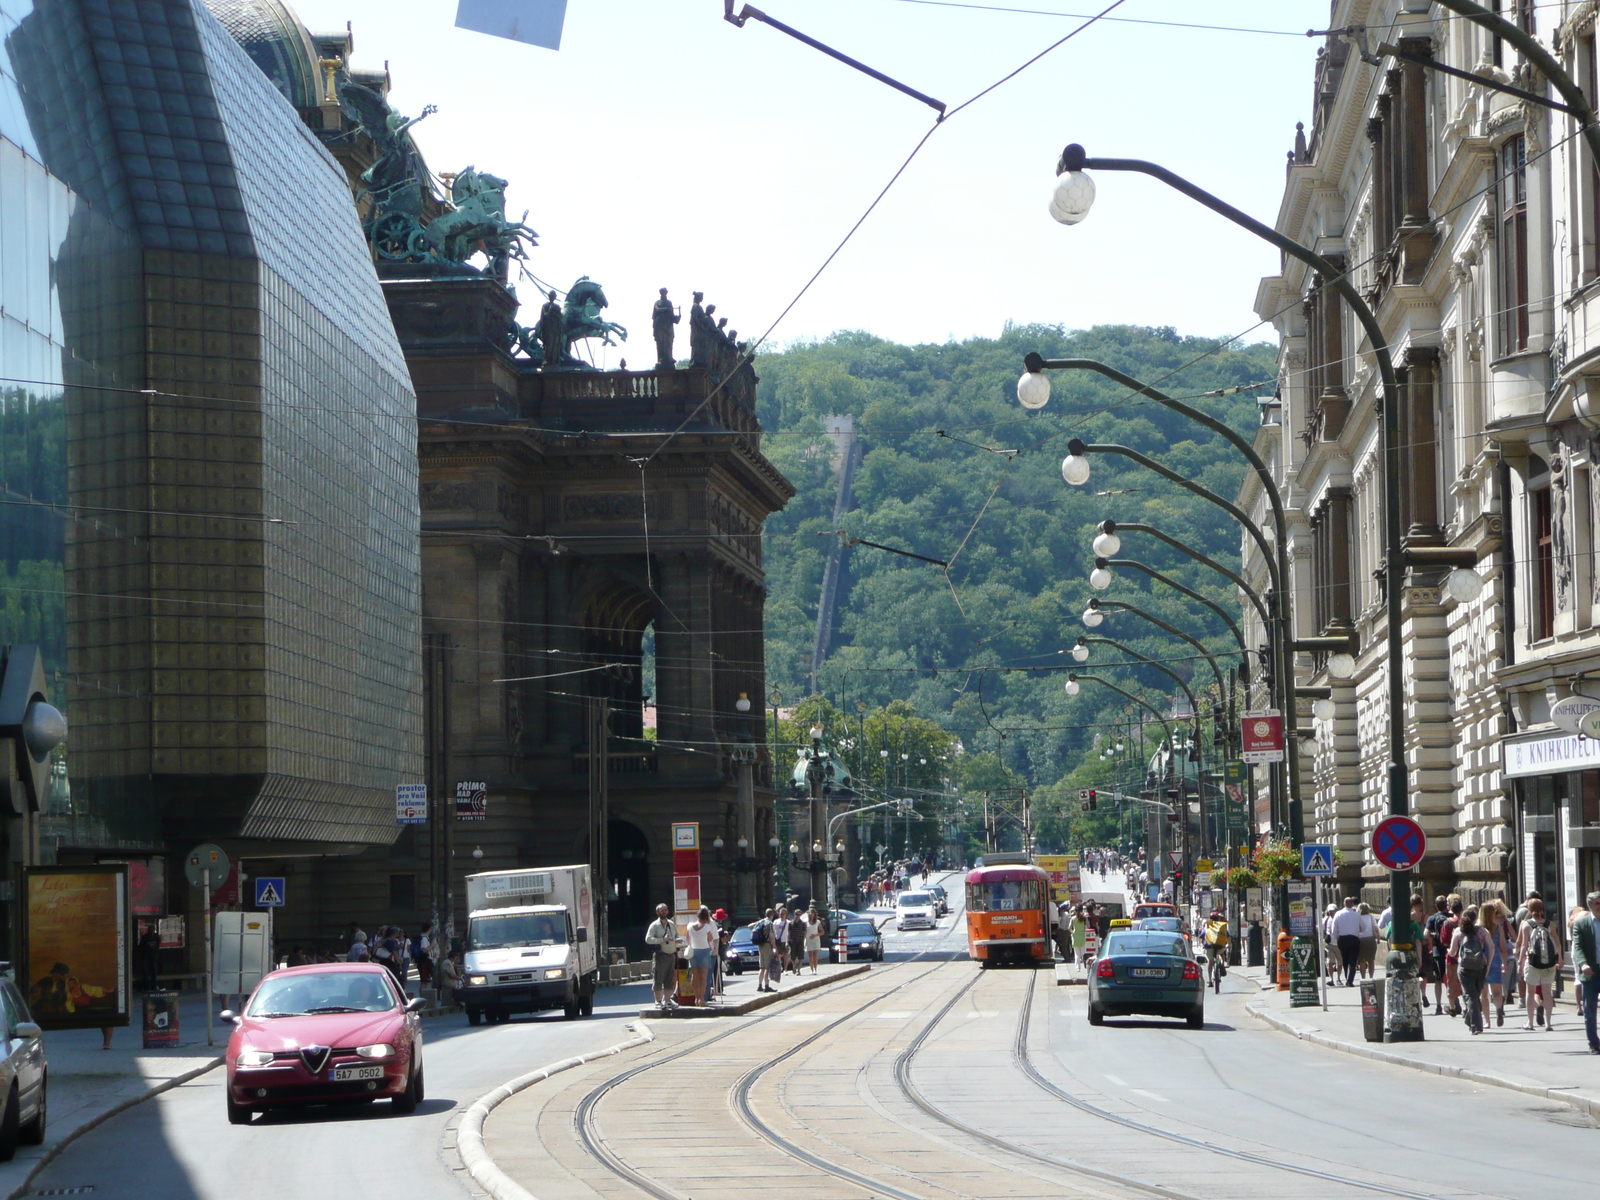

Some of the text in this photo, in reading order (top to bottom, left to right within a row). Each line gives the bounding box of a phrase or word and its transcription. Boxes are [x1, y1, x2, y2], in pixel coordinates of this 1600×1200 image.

[397, 784, 426, 793] prostor
[457, 781, 486, 790] PŘÍMO
[397, 793, 410, 801] pro
[457, 790, 471, 798] NAD
[397, 799, 426, 807] reklamu
[1002, 900, 1012, 908] 22
[336, 1067, 380, 1080] 5A7 0502
